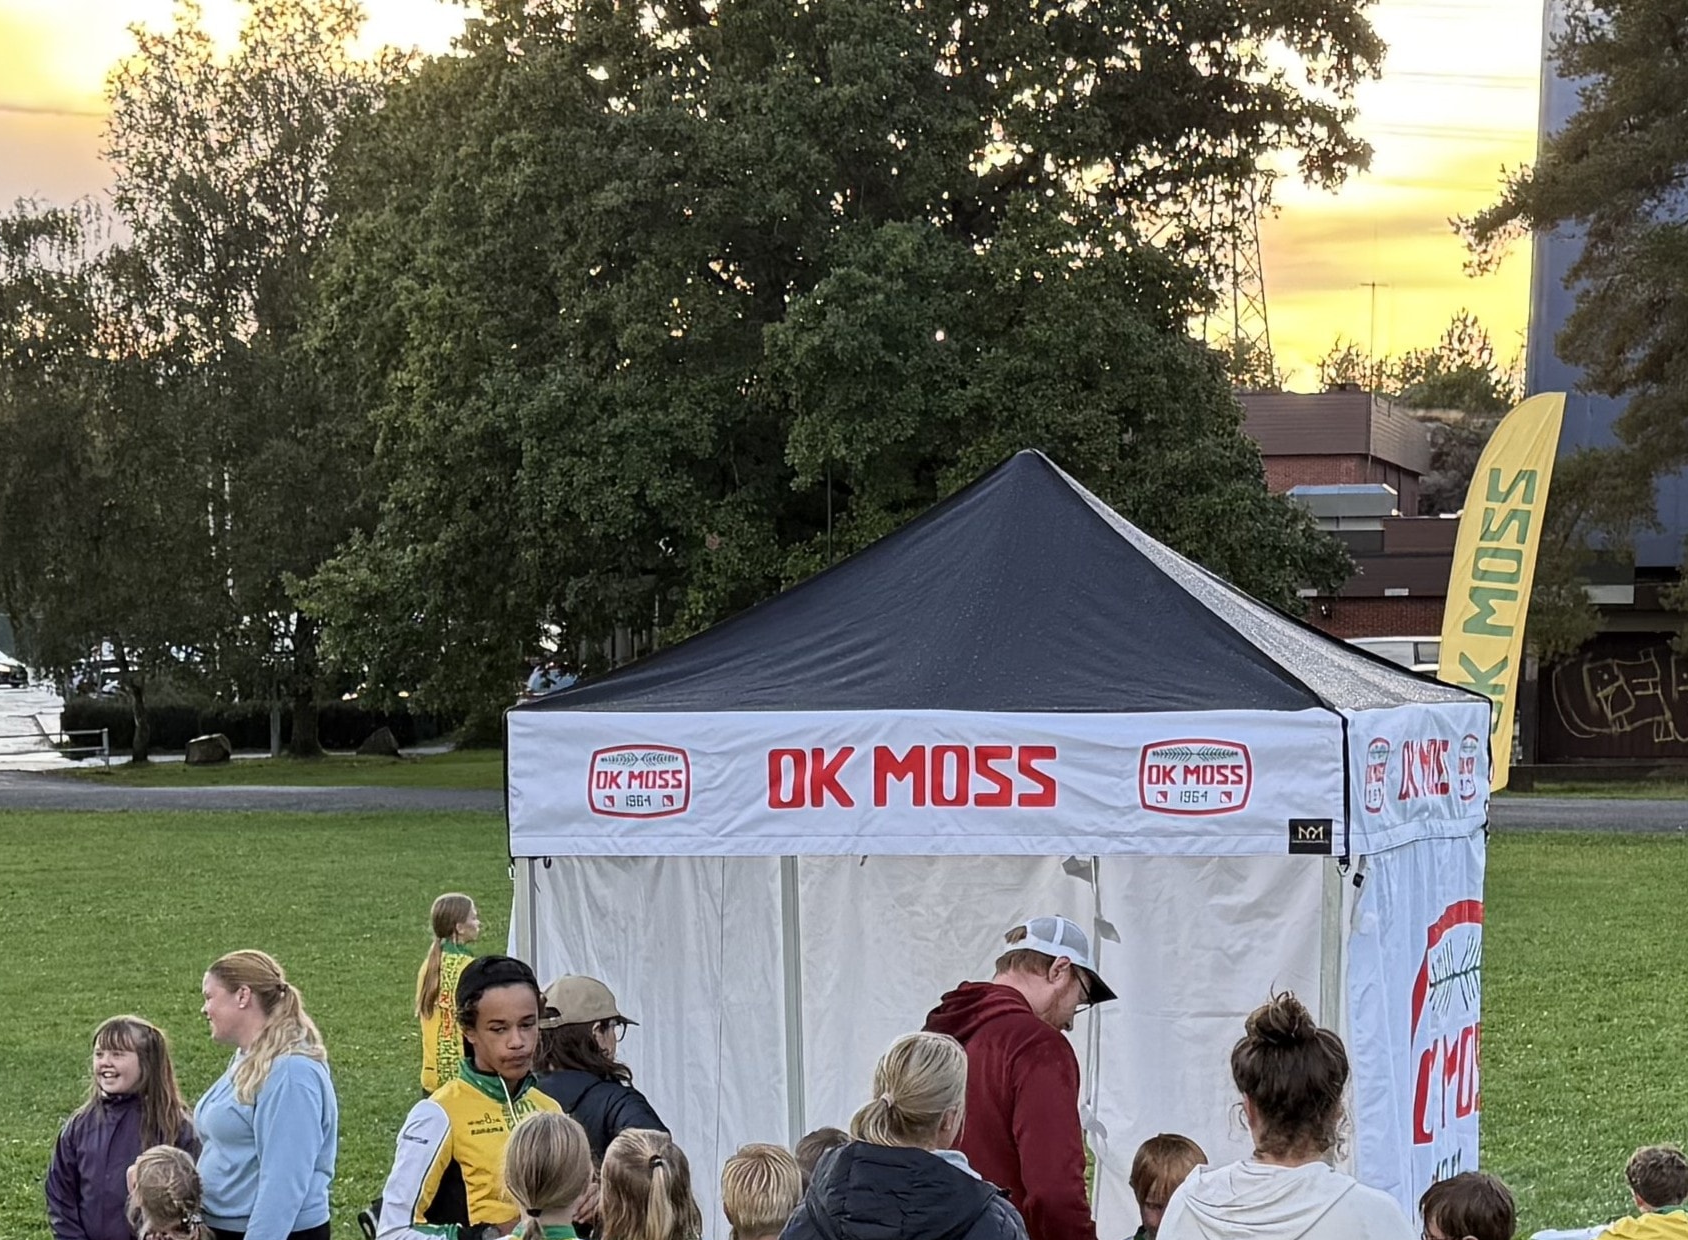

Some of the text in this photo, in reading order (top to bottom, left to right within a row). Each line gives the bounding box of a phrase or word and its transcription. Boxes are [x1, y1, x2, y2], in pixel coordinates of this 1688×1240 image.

[1458, 468, 1537, 735] K MOSS
[596, 769, 683, 789] OK MOSS
[768, 745, 1057, 808] OK MOSS
[1147, 764, 1244, 785] OK MOSS
[1180, 790, 1208, 803] 1964
